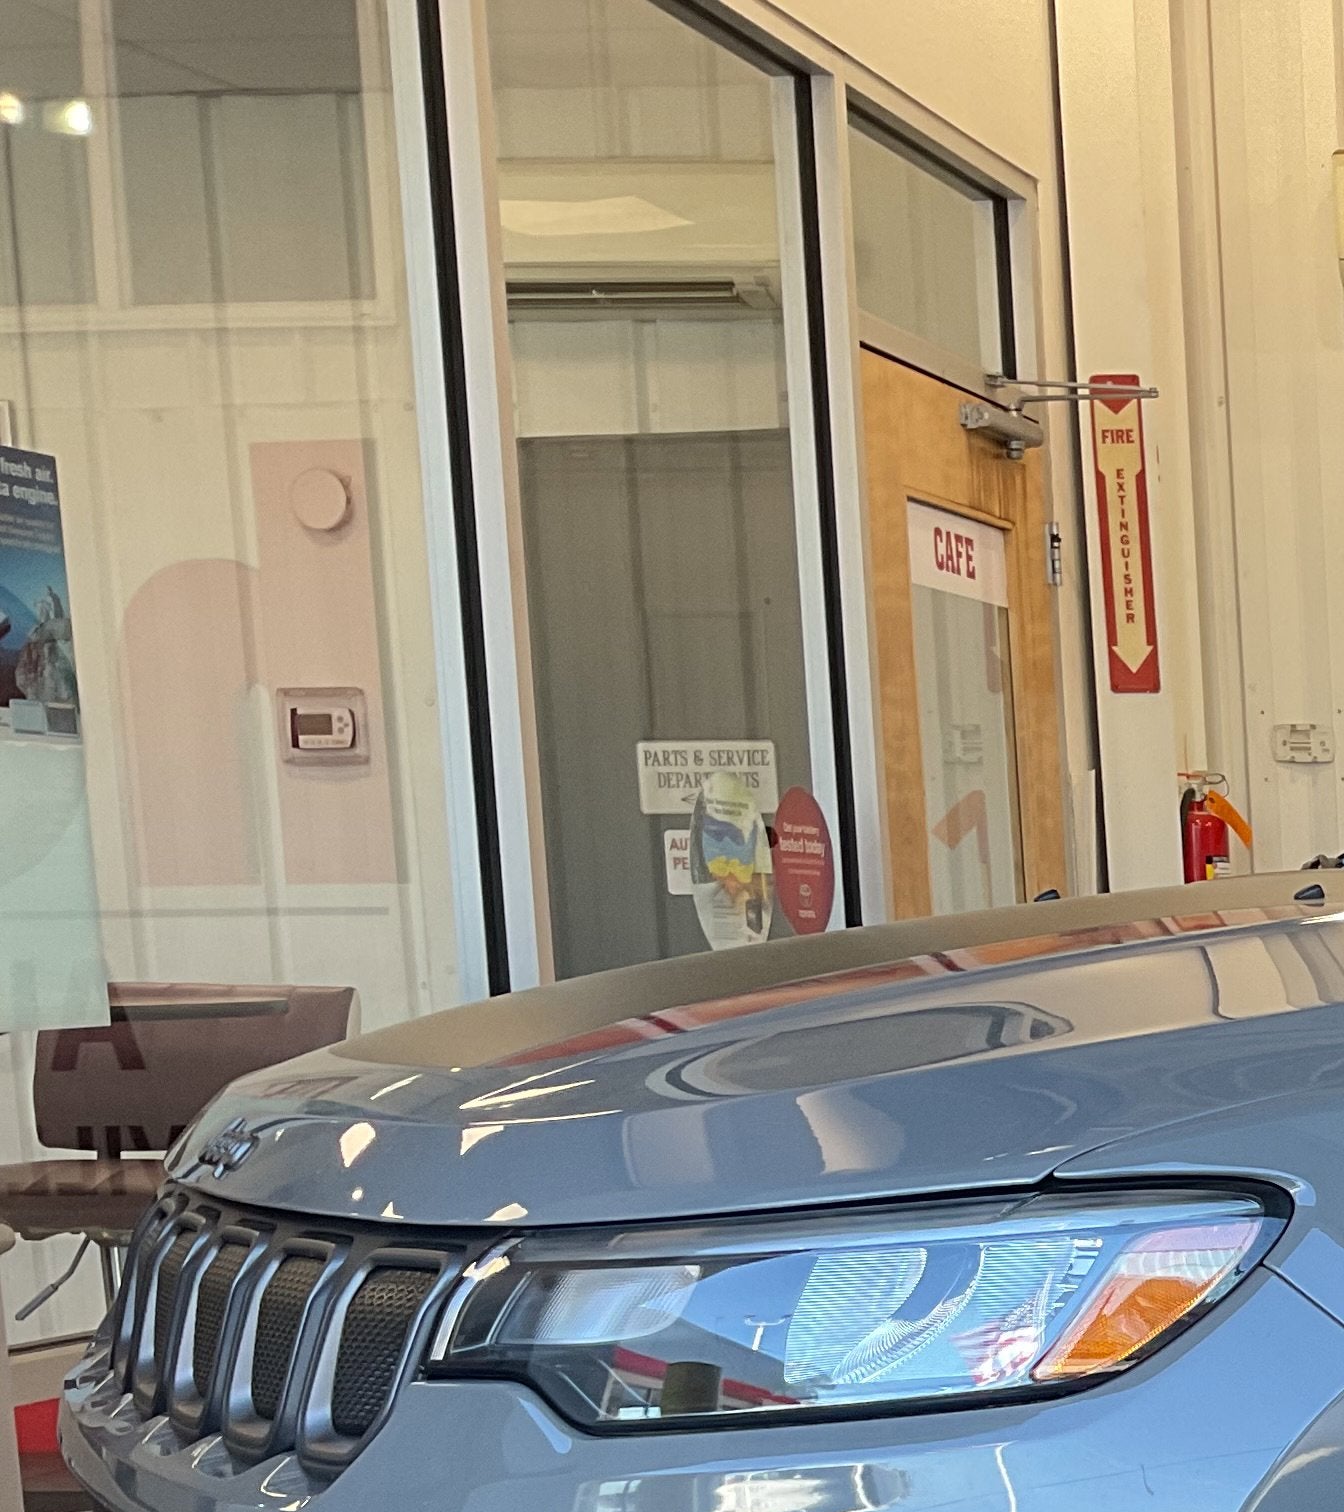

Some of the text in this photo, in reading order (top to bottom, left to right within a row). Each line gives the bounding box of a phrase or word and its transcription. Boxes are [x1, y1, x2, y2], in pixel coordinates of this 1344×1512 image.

[1101, 428, 1135, 444] FIRE
[934, 526, 976, 580] CAFE
[1116, 468, 1135, 624] EXTINGUISHER
[643, 750, 770, 767] PARTS & SERVICE
[657, 771, 760, 789] DEPARTTS
